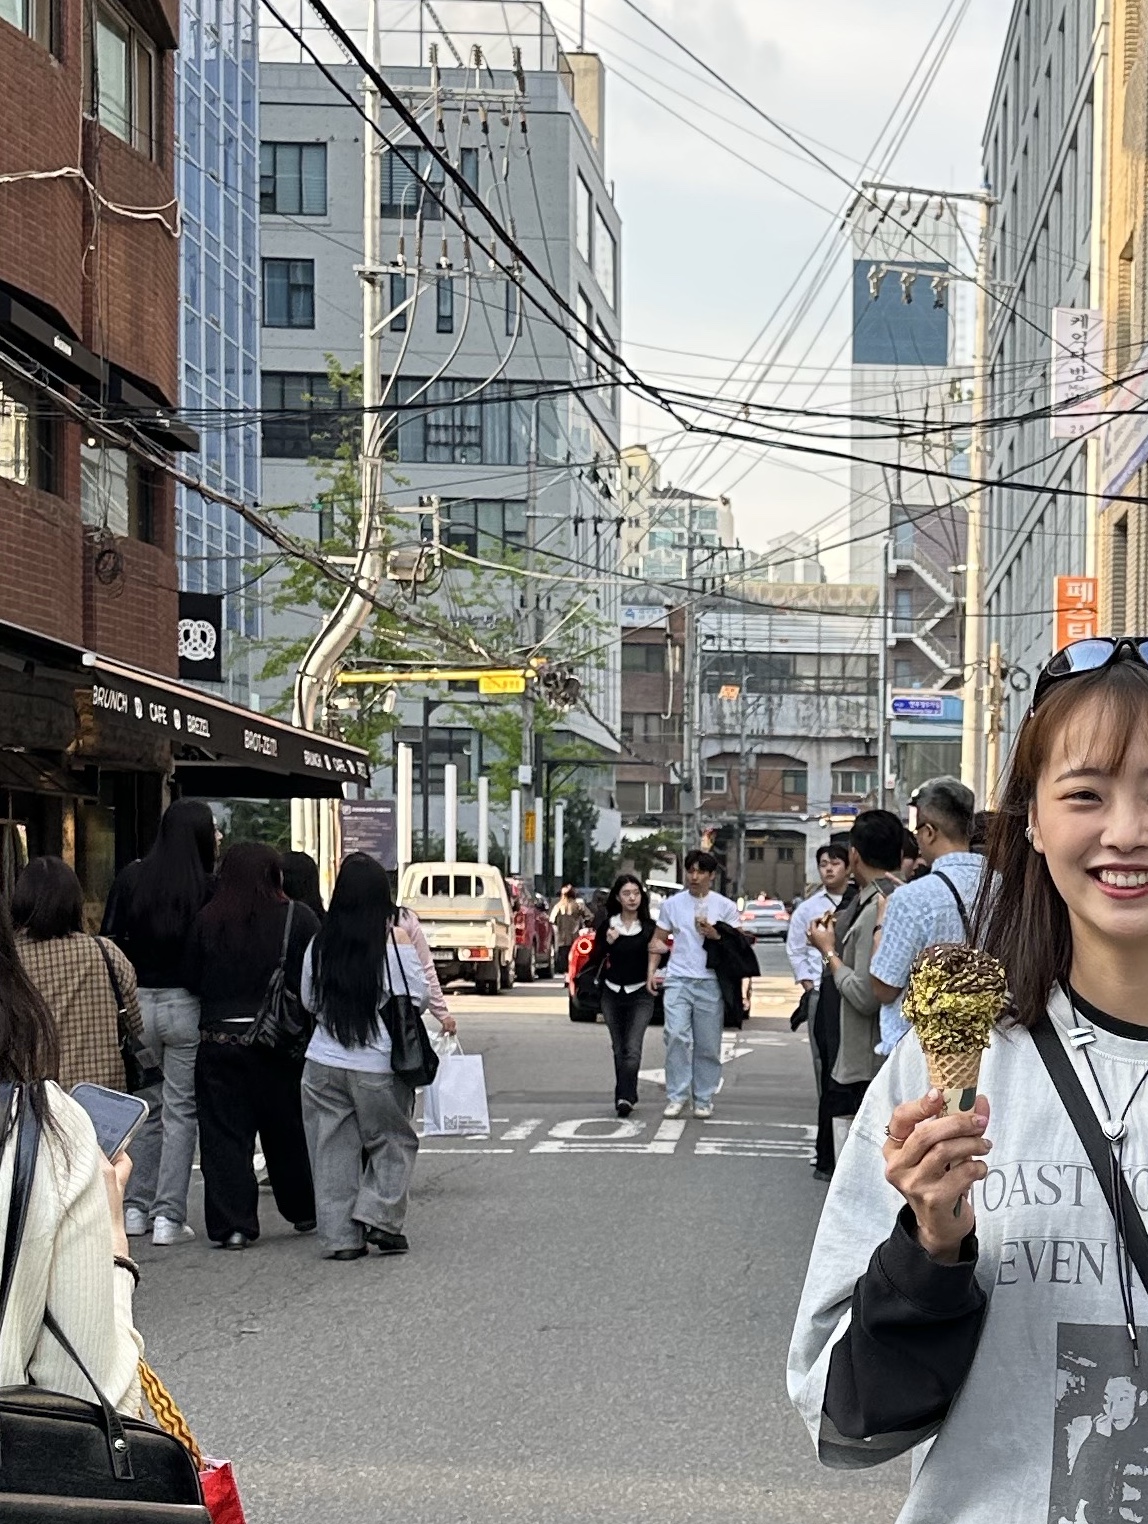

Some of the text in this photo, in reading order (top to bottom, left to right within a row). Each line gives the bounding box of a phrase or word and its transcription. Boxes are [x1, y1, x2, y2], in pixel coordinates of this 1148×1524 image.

[93, 685, 128, 714] BRUNCH
[149, 702, 168, 725] CAFE
[971, 1163, 1094, 1212] OAST
[996, 1240, 1108, 1286] EVEN
